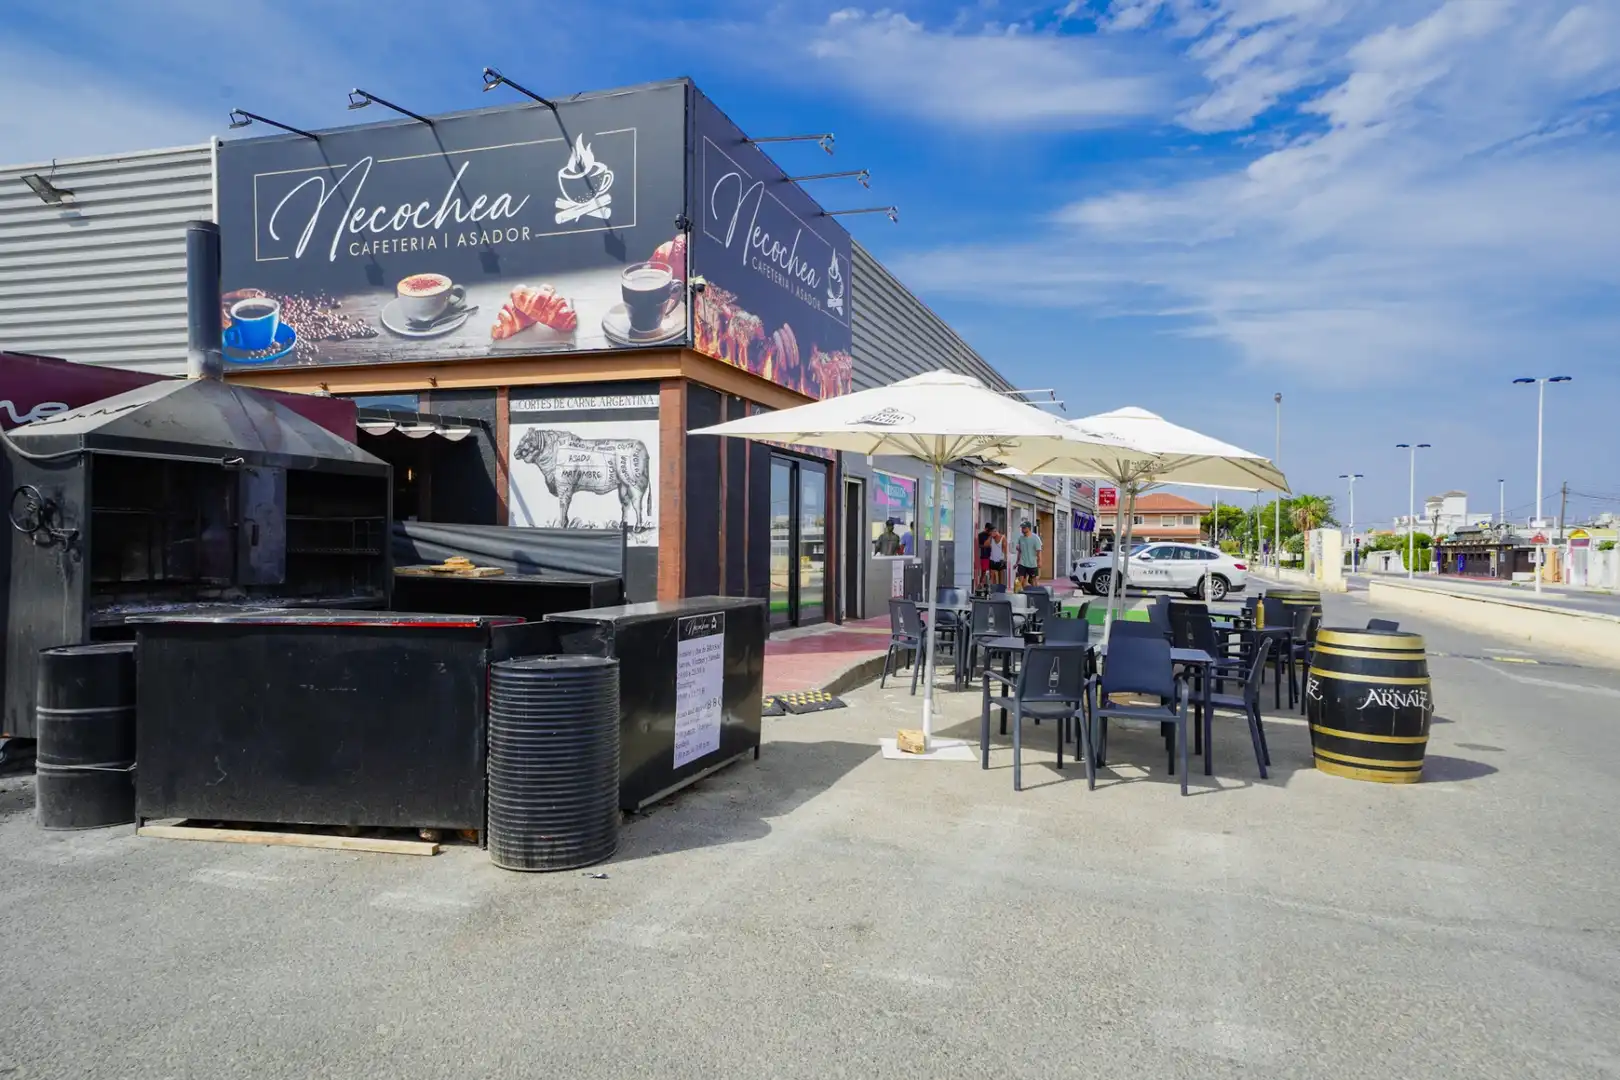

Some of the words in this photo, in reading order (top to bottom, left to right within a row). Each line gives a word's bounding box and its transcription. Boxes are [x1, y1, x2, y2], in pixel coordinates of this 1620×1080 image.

[269, 156, 530, 262] Necochea
[349, 236, 438, 257] CAFETERIA
[457, 226, 531, 248] ASADOR
[711, 172, 821, 289] Necochea
[751, 256, 790, 291] CAFETERIA
[795, 288, 821, 311] ASADOR
[553, 398, 564, 409] DE
[567, 397, 597, 408] CARNE
[599, 394, 655, 407] ARGENTINA
[568, 454, 591, 462] ASADO
[561, 469, 603, 480] MATAMBRE
